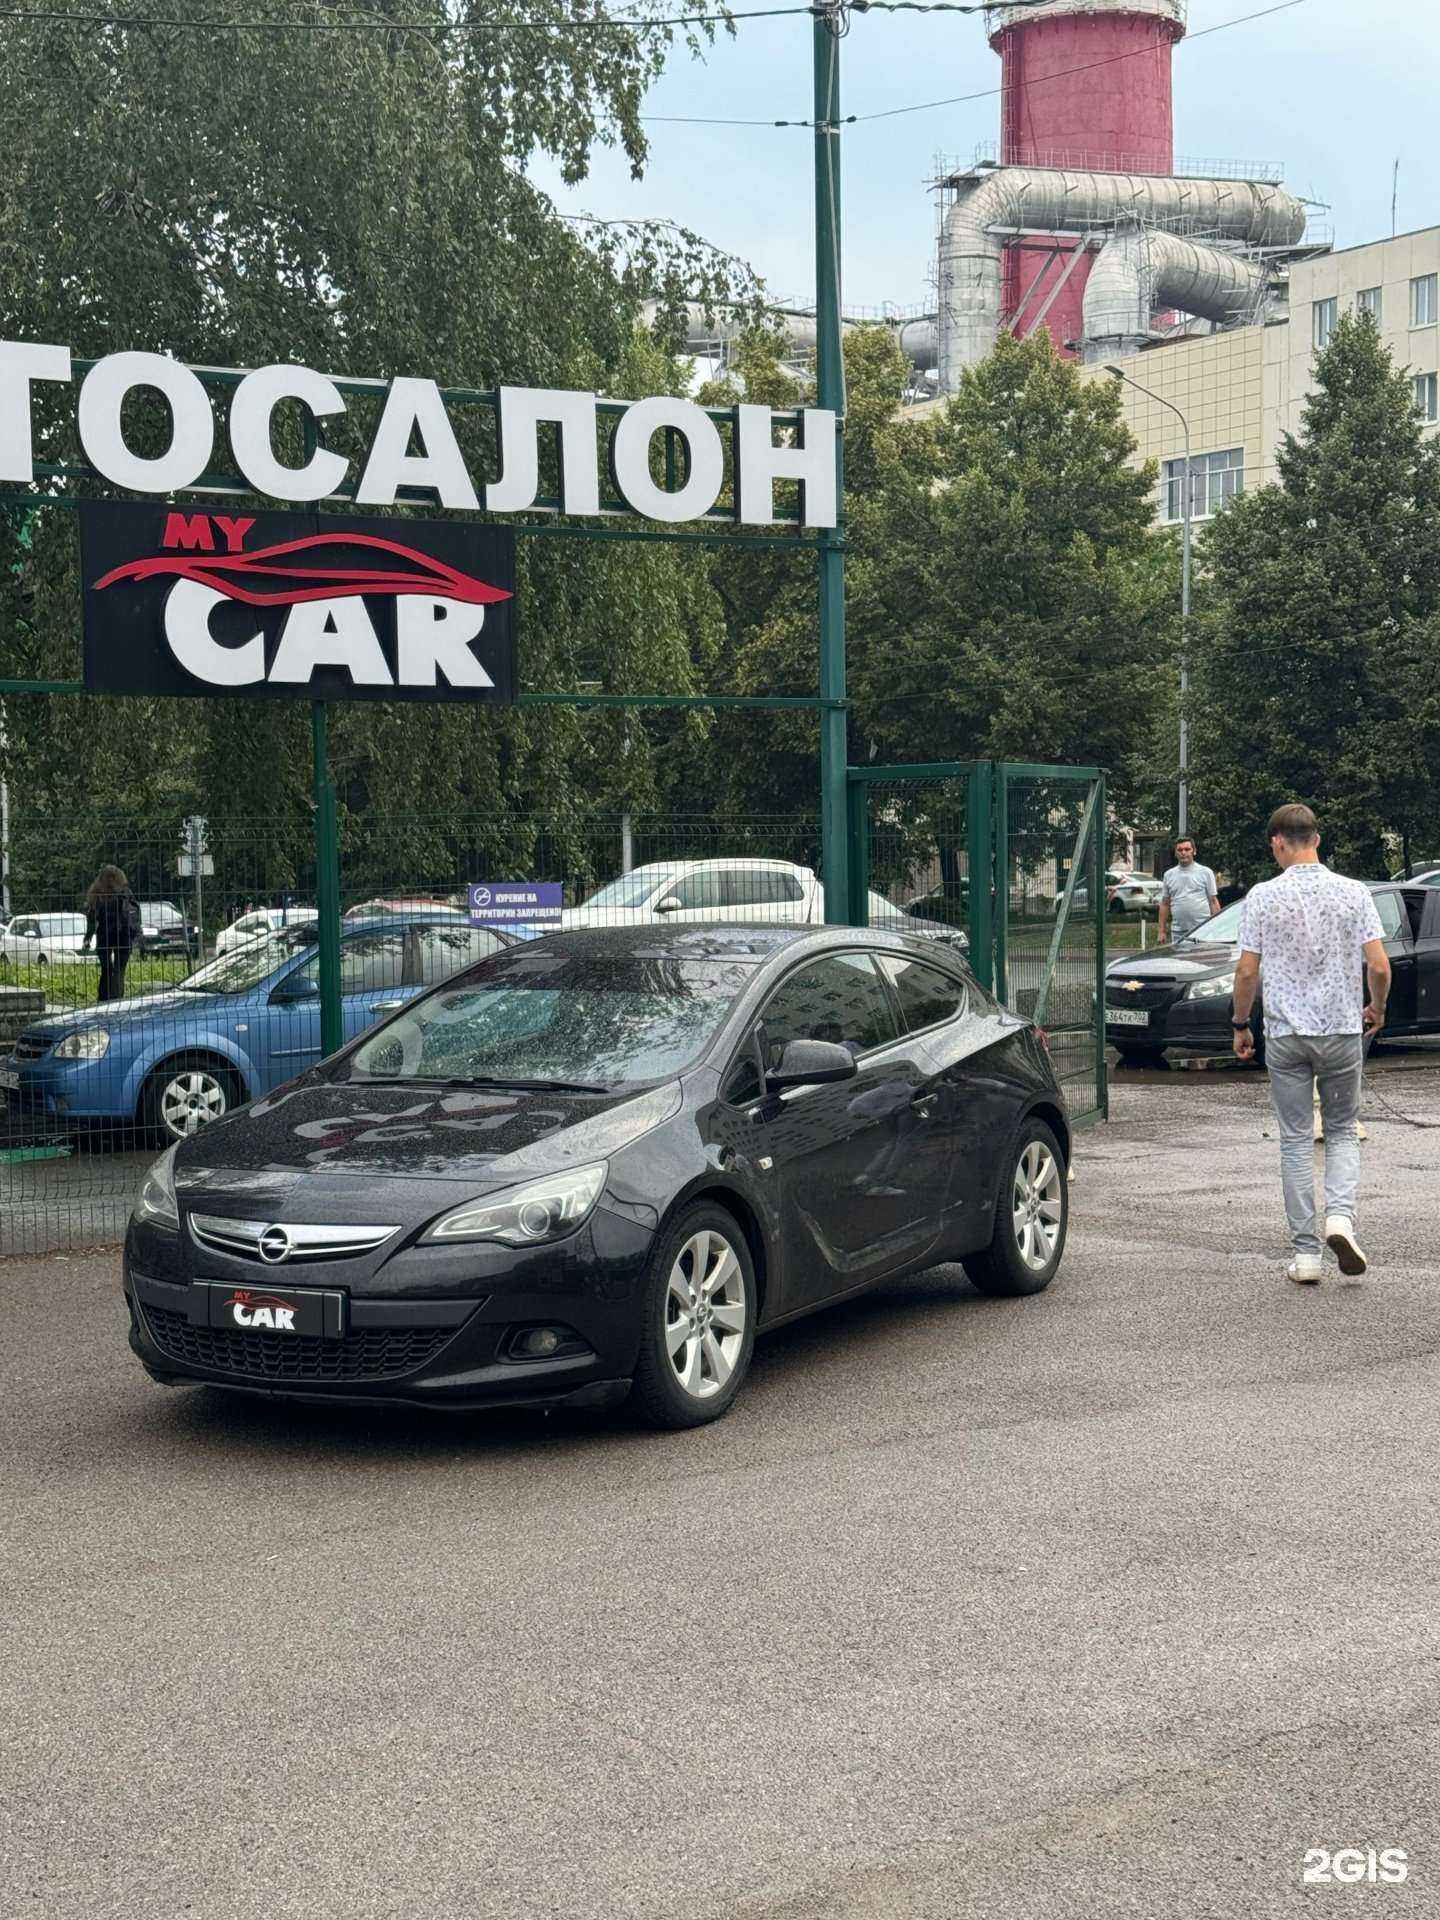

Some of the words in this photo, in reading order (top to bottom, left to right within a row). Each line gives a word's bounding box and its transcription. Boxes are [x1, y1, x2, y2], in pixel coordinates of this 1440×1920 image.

[0, 341, 837, 529] ТОСАЛОН
[163, 512, 256, 552] MY
[165, 577, 495, 688] CAR
[233, 1290, 250, 1300] MY
[233, 1302, 296, 1331] CAR
